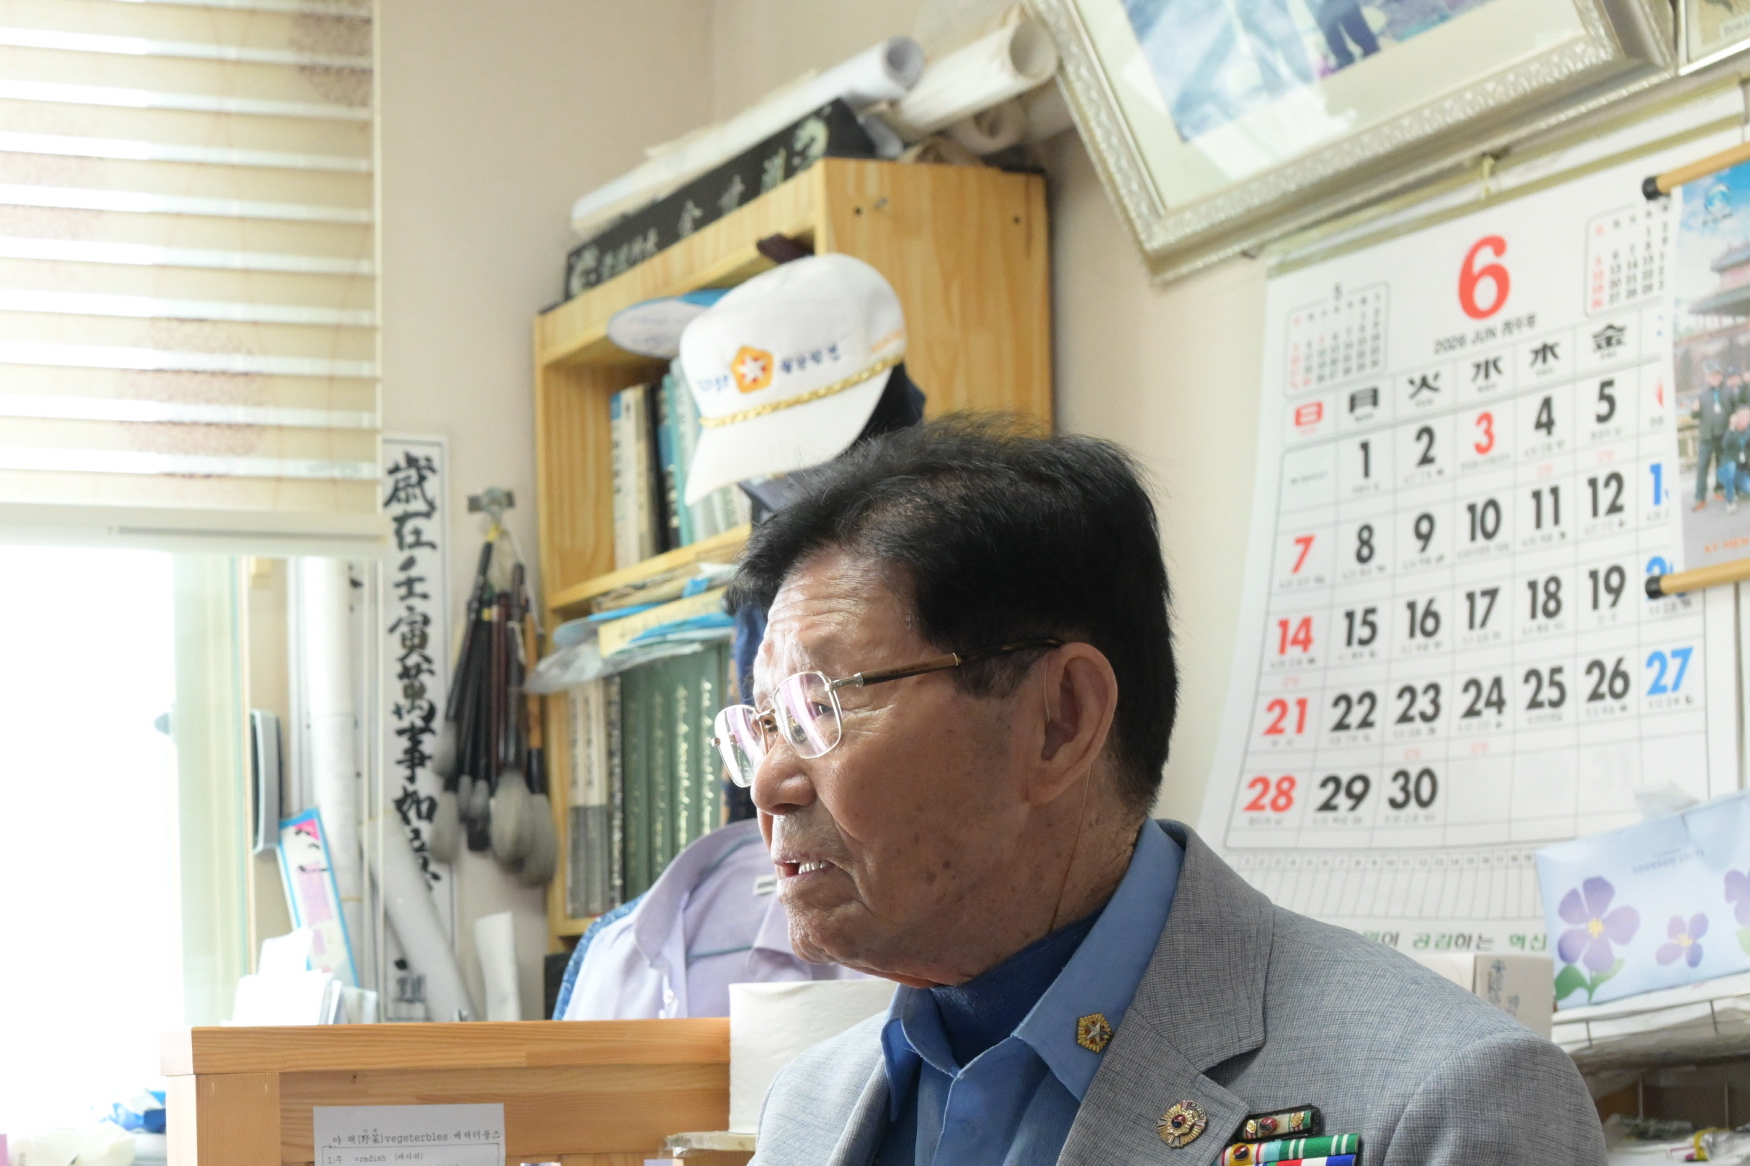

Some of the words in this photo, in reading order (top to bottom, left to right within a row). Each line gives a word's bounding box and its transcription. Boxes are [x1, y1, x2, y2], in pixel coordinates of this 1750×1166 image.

[1458, 236, 1510, 319] 6
[1294, 402, 1323, 428] 日
[1349, 386, 1379, 413] 月
[1408, 372, 1441, 399] 火
[1471, 356, 1503, 382] 水
[1529, 341, 1561, 367] 木
[1592, 323, 1627, 353] 金
[1360, 441, 1369, 478] 1
[1416, 426, 1435, 466] 2
[1475, 412, 1494, 454] 3
[1535, 396, 1555, 435] 4
[1596, 379, 1616, 423] 5
[1293, 535, 1314, 573] 7
[1356, 524, 1374, 564] 8
[1414, 513, 1435, 552] 9
[1467, 499, 1501, 542] 10
[1532, 486, 1560, 529] 11
[1588, 472, 1624, 517] 12
[1279, 617, 1313, 655] 14
[1345, 608, 1377, 647] 15
[1407, 599, 1440, 638] 16
[1466, 588, 1499, 630] 17
[1528, 576, 1562, 619] 18
[1589, 565, 1625, 610] 19
[1264, 698, 1307, 735] 21
[1331, 691, 1377, 732] 22
[1396, 683, 1440, 724] 23
[1462, 677, 1506, 718] 24
[1524, 667, 1566, 710] 25
[1586, 658, 1630, 702] 26
[1646, 648, 1693, 695] 27
[1244, 776, 1296, 812] 28
[1317, 774, 1371, 811] 29
[1388, 768, 1438, 810] 30
[332, 1135, 342, 1145] 야
